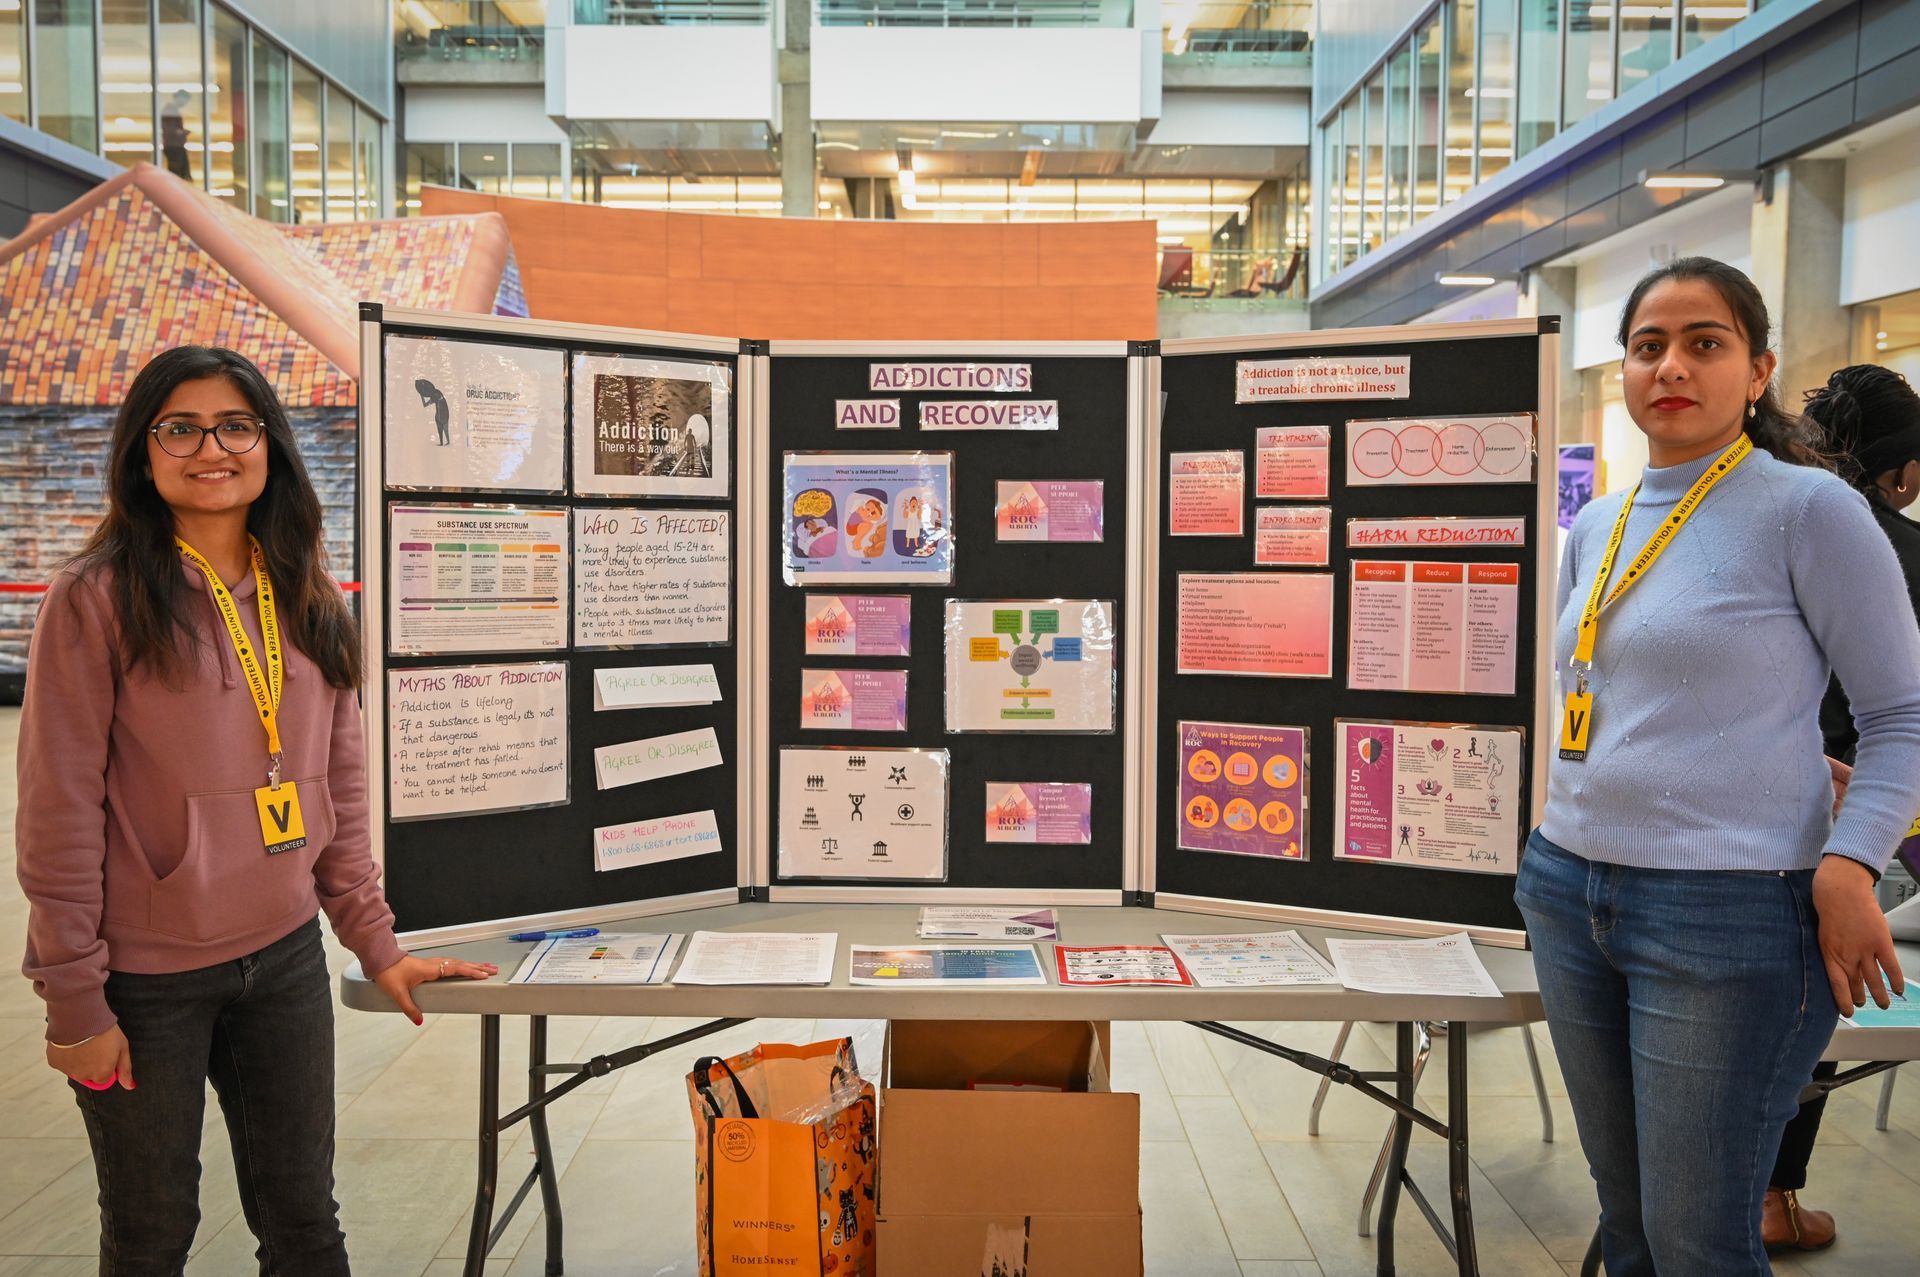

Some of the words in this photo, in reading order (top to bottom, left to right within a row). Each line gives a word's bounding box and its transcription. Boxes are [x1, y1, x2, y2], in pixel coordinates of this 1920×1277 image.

[873, 367, 1028, 388] ADDICTIONS
[1242, 368, 1294, 379] Addiction
[1309, 368, 1329, 377] not
[1331, 368, 1338, 376] a
[1340, 366, 1381, 377] choice,
[1384, 365, 1406, 375] but
[1250, 388, 1255, 396] a
[1258, 385, 1308, 395] treatable
[1310, 384, 1354, 393] chronic
[1356, 383, 1396, 392] illness
[840, 404, 896, 424] AND
[925, 405, 1053, 425] RECOVERY
[599, 421, 679, 441] Addiction
[600, 441, 625, 453] There
[628, 444, 635, 453] is
[639, 444, 644, 453] a
[647, 444, 664, 455] way
[1678, 471, 1719, 515] VOLUNTEER
[437, 521, 477, 529] SUBSTANCE
[584, 514, 619, 535] WHO
[630, 517, 648, 535] IS
[657, 515, 726, 536] AFFECTED?
[1010, 516, 1037, 524] ROC
[1357, 529, 1408, 542] HARM
[1417, 527, 1518, 542] REDUCTION
[584, 544, 609, 561] Young
[616, 542, 644, 557] people
[646, 541, 669, 556] aged
[674, 542, 698, 552] 15-24
[1635, 525, 1674, 571] VOLUNTEER
[609, 558, 629, 569] likely
[645, 555, 687, 570] experience
[605, 569, 644, 577] disorders
[584, 583, 605, 593] Men
[609, 584, 628, 592] have
[633, 583, 657, 593] higher
[683, 579, 690, 591] of
[602, 595, 639, 603] disorders
[221, 596, 245, 646] VOLUNTEER
[584, 608, 609, 621] People
[636, 607, 676, 616] substance
[264, 604, 277, 652] VOLUNTEER
[598, 620, 615, 630] upto
[675, 616, 694, 626] likely
[594, 629, 624, 638] mental
[818, 630, 844, 638] ROC
[244, 656, 268, 708] VOLUNTEER
[399, 677, 446, 693] MYTHS
[452, 673, 492, 689] ABOUT
[500, 670, 562, 685] ADDICTION
[606, 675, 647, 690] AGREE
[651, 673, 667, 687] OR
[671, 673, 716, 687] DISAGREE
[400, 700, 452, 713] Addiction
[461, 700, 469, 708] is
[476, 697, 513, 710] lifelong
[814, 704, 841, 712] ROC
[399, 719, 412, 733] If
[415, 721, 423, 729] a
[428, 717, 479, 728] substance
[484, 715, 491, 723] is
[496, 712, 520, 726] legal,
[540, 708, 555, 718] not
[1570, 710, 1585, 741] V
[401, 735, 424, 745] that
[430, 732, 478, 745] dangerous
[1229, 741, 1262, 749] Recovery
[1399, 734, 1405, 744] 1
[400, 750, 408, 760] A
[415, 748, 448, 762] relapse
[452, 746, 473, 758] after
[479, 744, 501, 753] rehab
[507, 742, 535, 750] means
[539, 737, 557, 746] that
[603, 756, 641, 771] AGREE
[648, 746, 664, 759] OR
[669, 740, 715, 757] DISAGREE
[1454, 749, 1461, 758] 2
[1560, 749, 1584, 760] VOLUNTEER
[400, 764, 417, 773] the
[426, 759, 470, 771] treatment
[474, 757, 490, 765] has
[404, 778, 420, 788] You
[427, 776, 456, 786] cannot
[460, 773, 477, 785] help
[482, 770, 516, 779] someone
[521, 767, 537, 775] who
[1351, 770, 1360, 782] 5
[403, 791, 424, 799] want
[431, 789, 439, 797] to
[1398, 785, 1405, 794] 3
[1445, 793, 1453, 802] 4
[267, 800, 291, 833] V
[999, 817, 1025, 825] ROC
[602, 831, 626, 841] KIDS
[633, 826, 658, 838] HELP
[663, 819, 696, 832] PHONE
[1418, 827, 1425, 837] 5
[268, 839, 306, 854] VOLUNTEER
